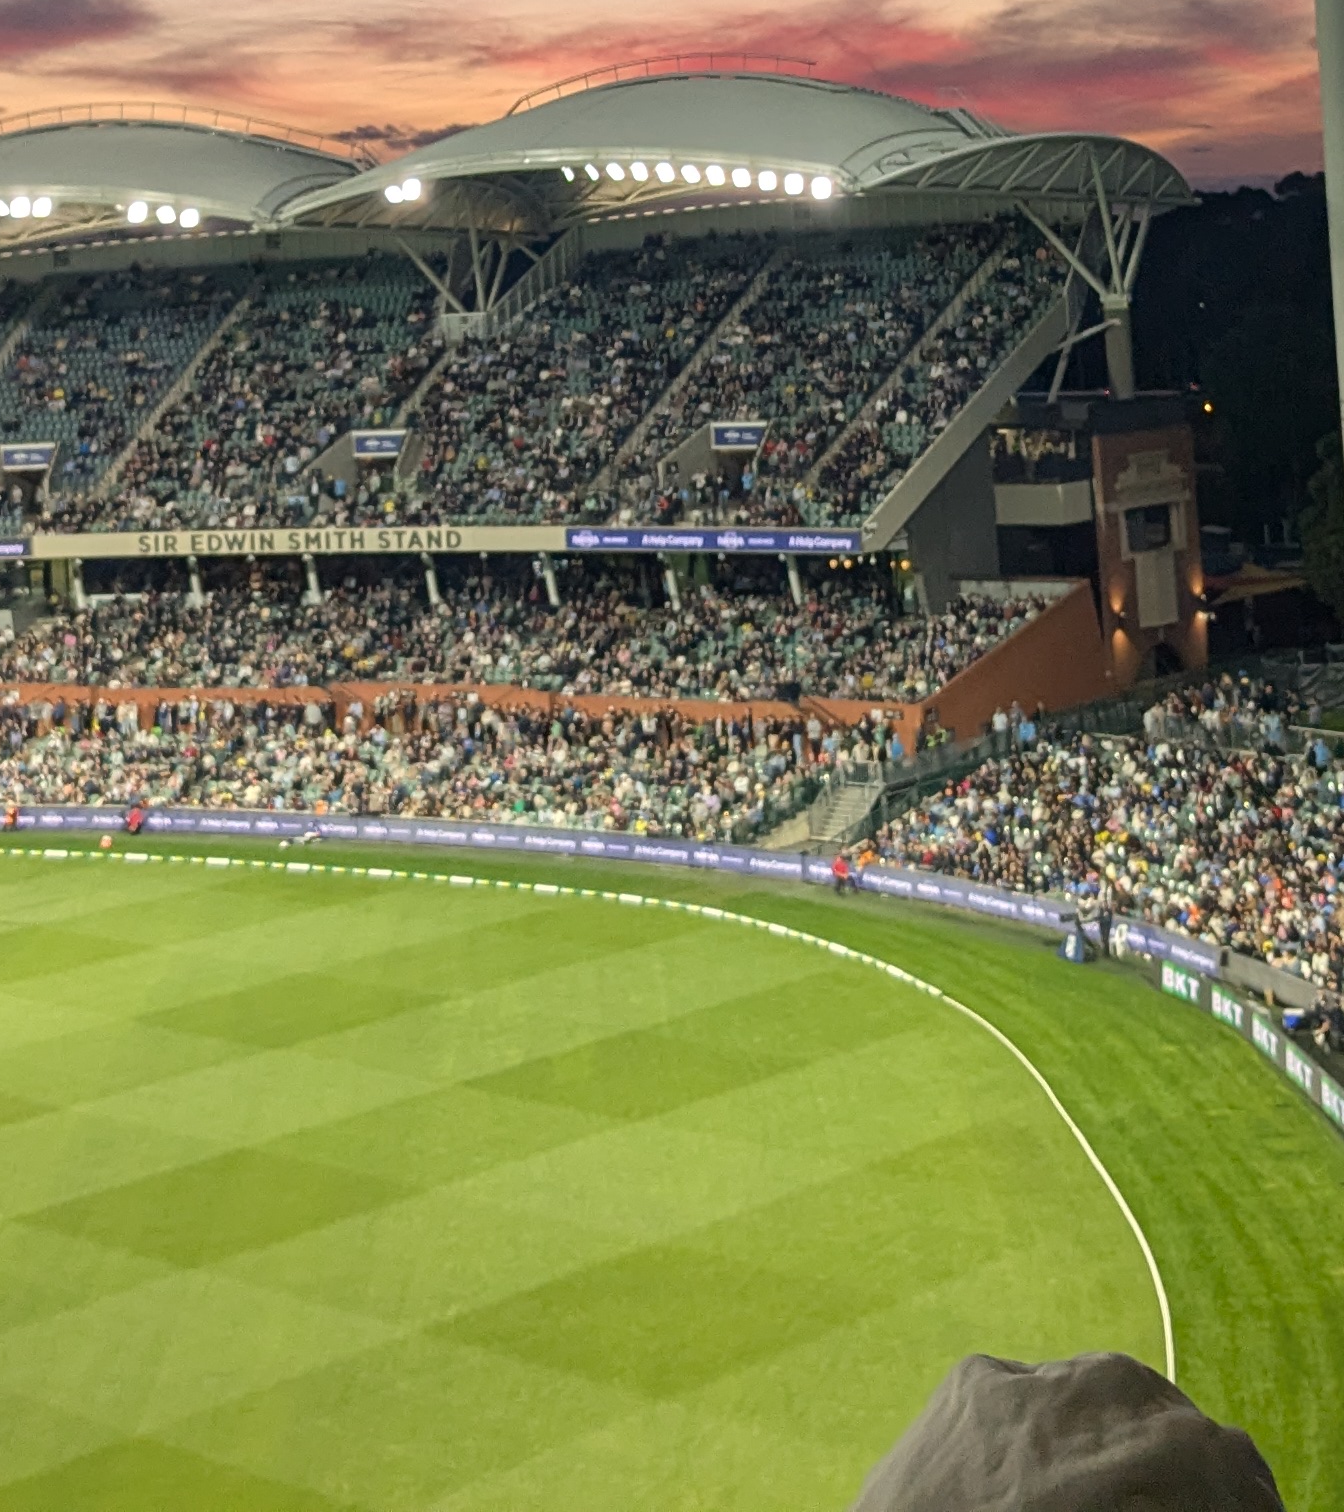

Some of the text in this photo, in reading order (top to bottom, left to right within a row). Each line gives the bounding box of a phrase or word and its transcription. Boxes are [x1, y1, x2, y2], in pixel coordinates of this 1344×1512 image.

[138, 530, 462, 554] SIR EDWIN SMITH STAND
[1162, 963, 1200, 1003] BKT
[1211, 986, 1243, 1029] BKT
